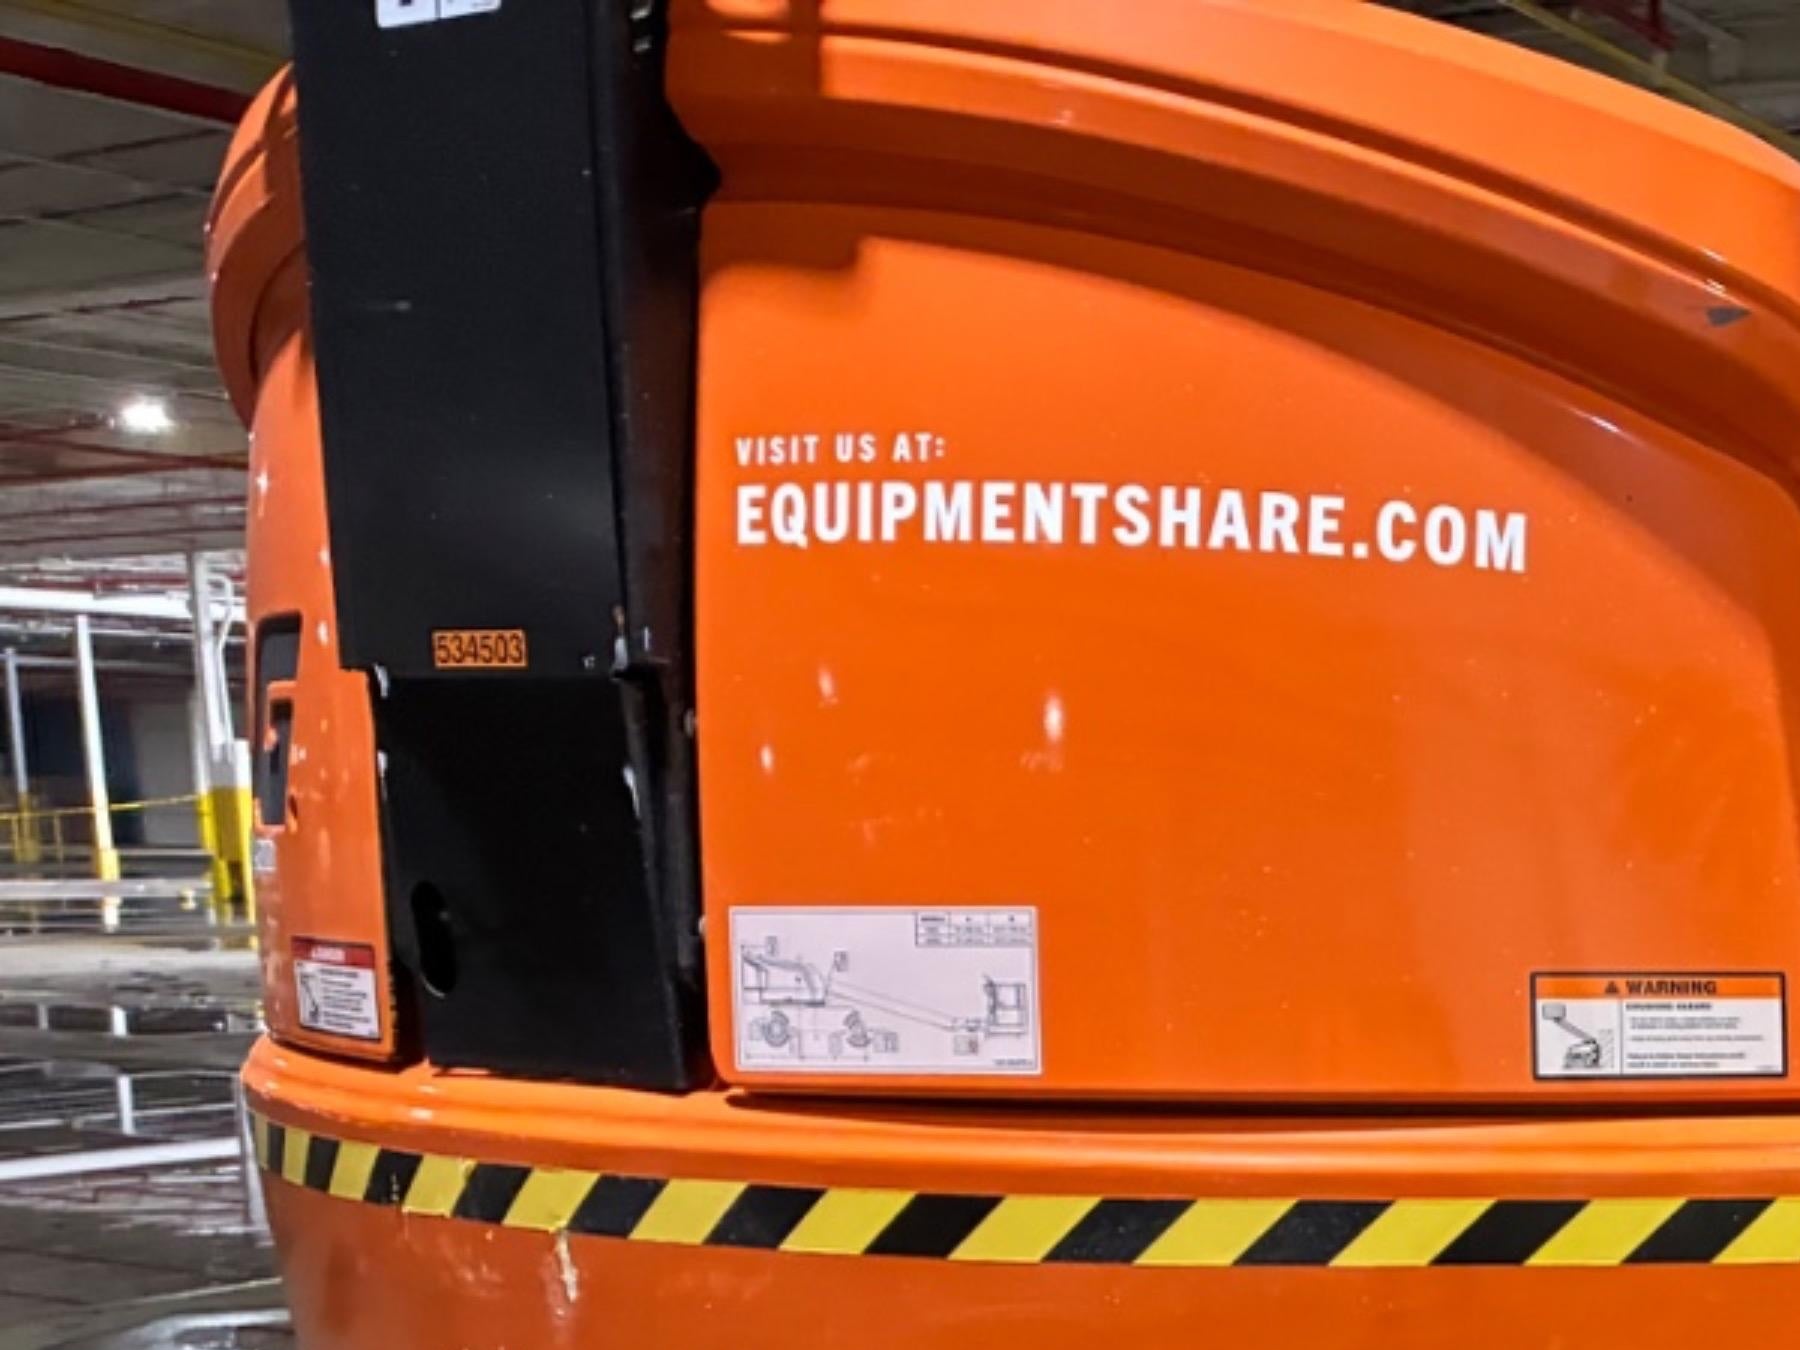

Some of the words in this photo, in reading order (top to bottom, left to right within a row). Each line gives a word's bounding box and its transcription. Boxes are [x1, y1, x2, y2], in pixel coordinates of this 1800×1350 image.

[736, 434, 819, 465] VISIT
[835, 433, 876, 462] US
[893, 432, 943, 461] AT:
[737, 480, 1527, 572] EQUIPMENTSHARE.COM
[436, 632, 523, 664] 534503
[1625, 980, 1717, 996] WARNING
